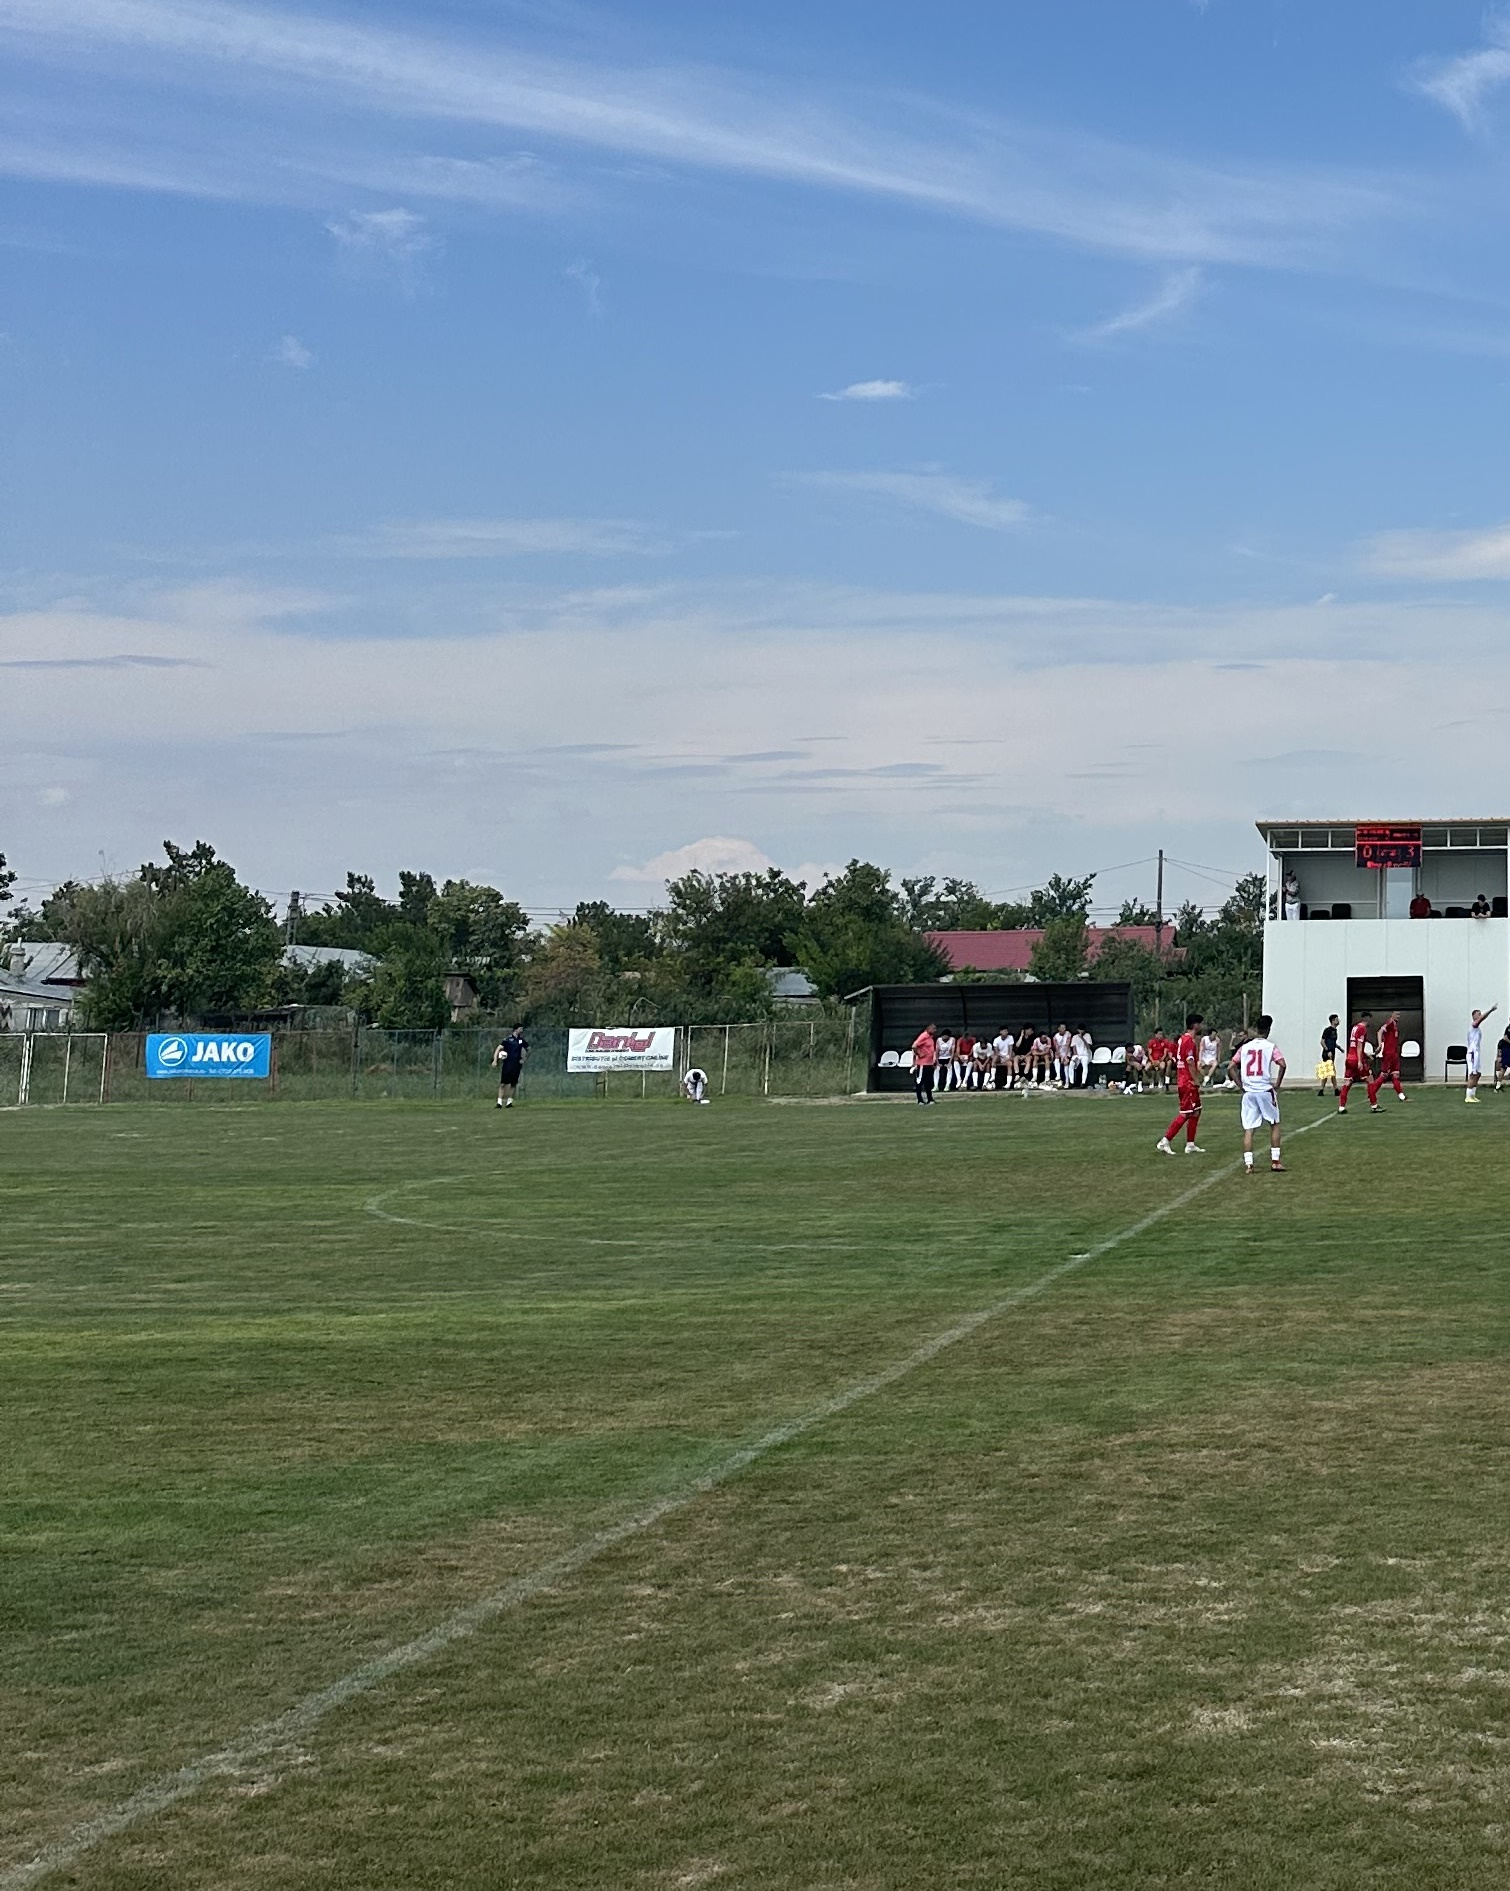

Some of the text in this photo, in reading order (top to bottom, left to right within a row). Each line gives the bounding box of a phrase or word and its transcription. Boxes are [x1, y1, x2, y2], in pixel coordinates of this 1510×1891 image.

[1363, 845, 1373, 858] 0
[1405, 845, 1414, 858] 3
[192, 1041, 255, 1062] JAKO
[1246, 1049, 1263, 1076] 21
